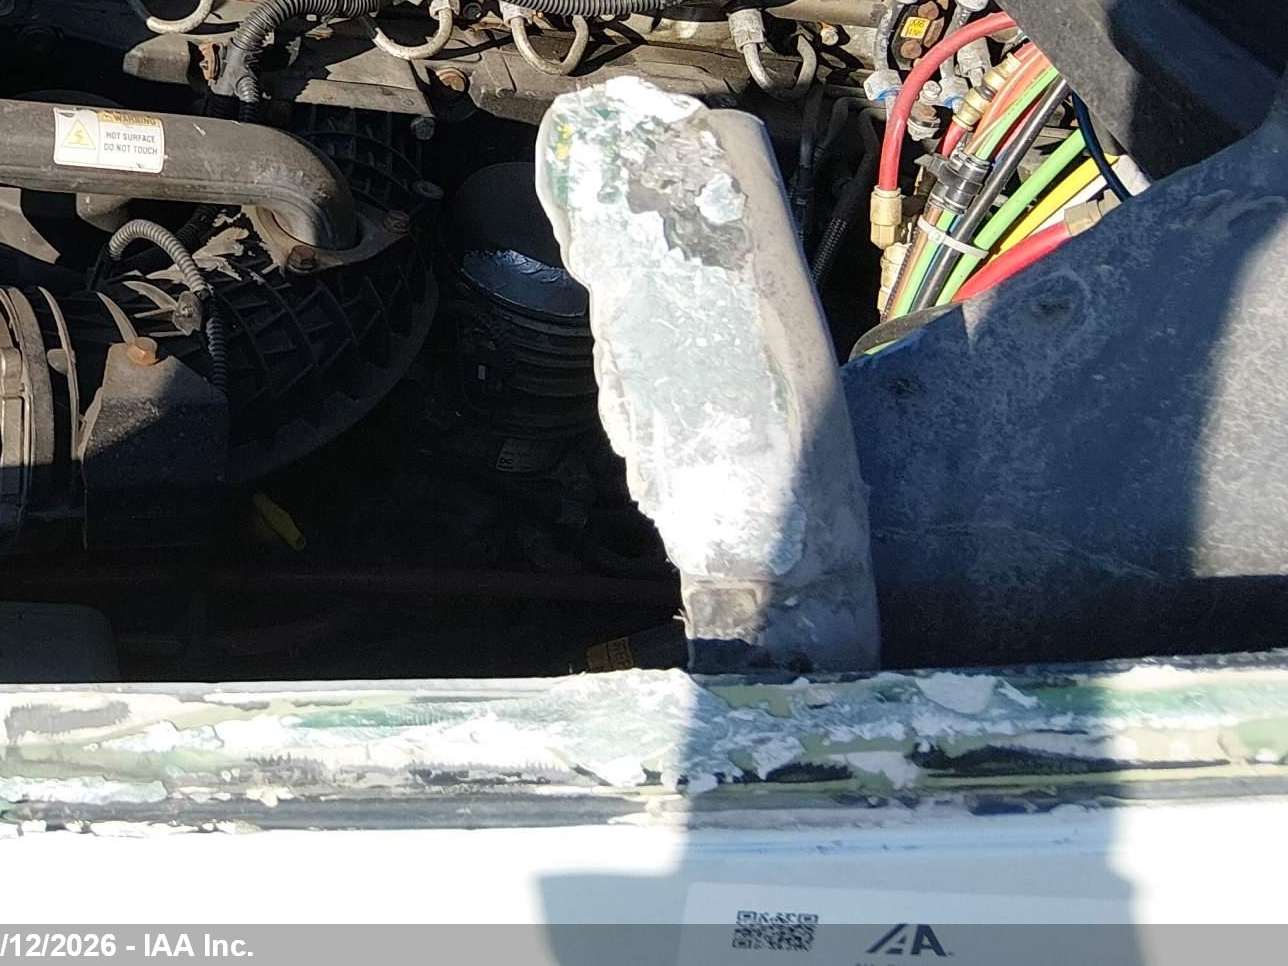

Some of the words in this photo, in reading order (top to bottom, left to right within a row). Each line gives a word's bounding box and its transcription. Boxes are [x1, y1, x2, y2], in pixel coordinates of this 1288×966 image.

[113, 114, 156, 125] WARNING
[106, 131, 120, 139] HOT
[123, 133, 155, 143] SURFACE
[104, 143, 114, 151] DO
[116, 144, 131, 152] NOT
[133, 146, 158, 155] TOUCH
